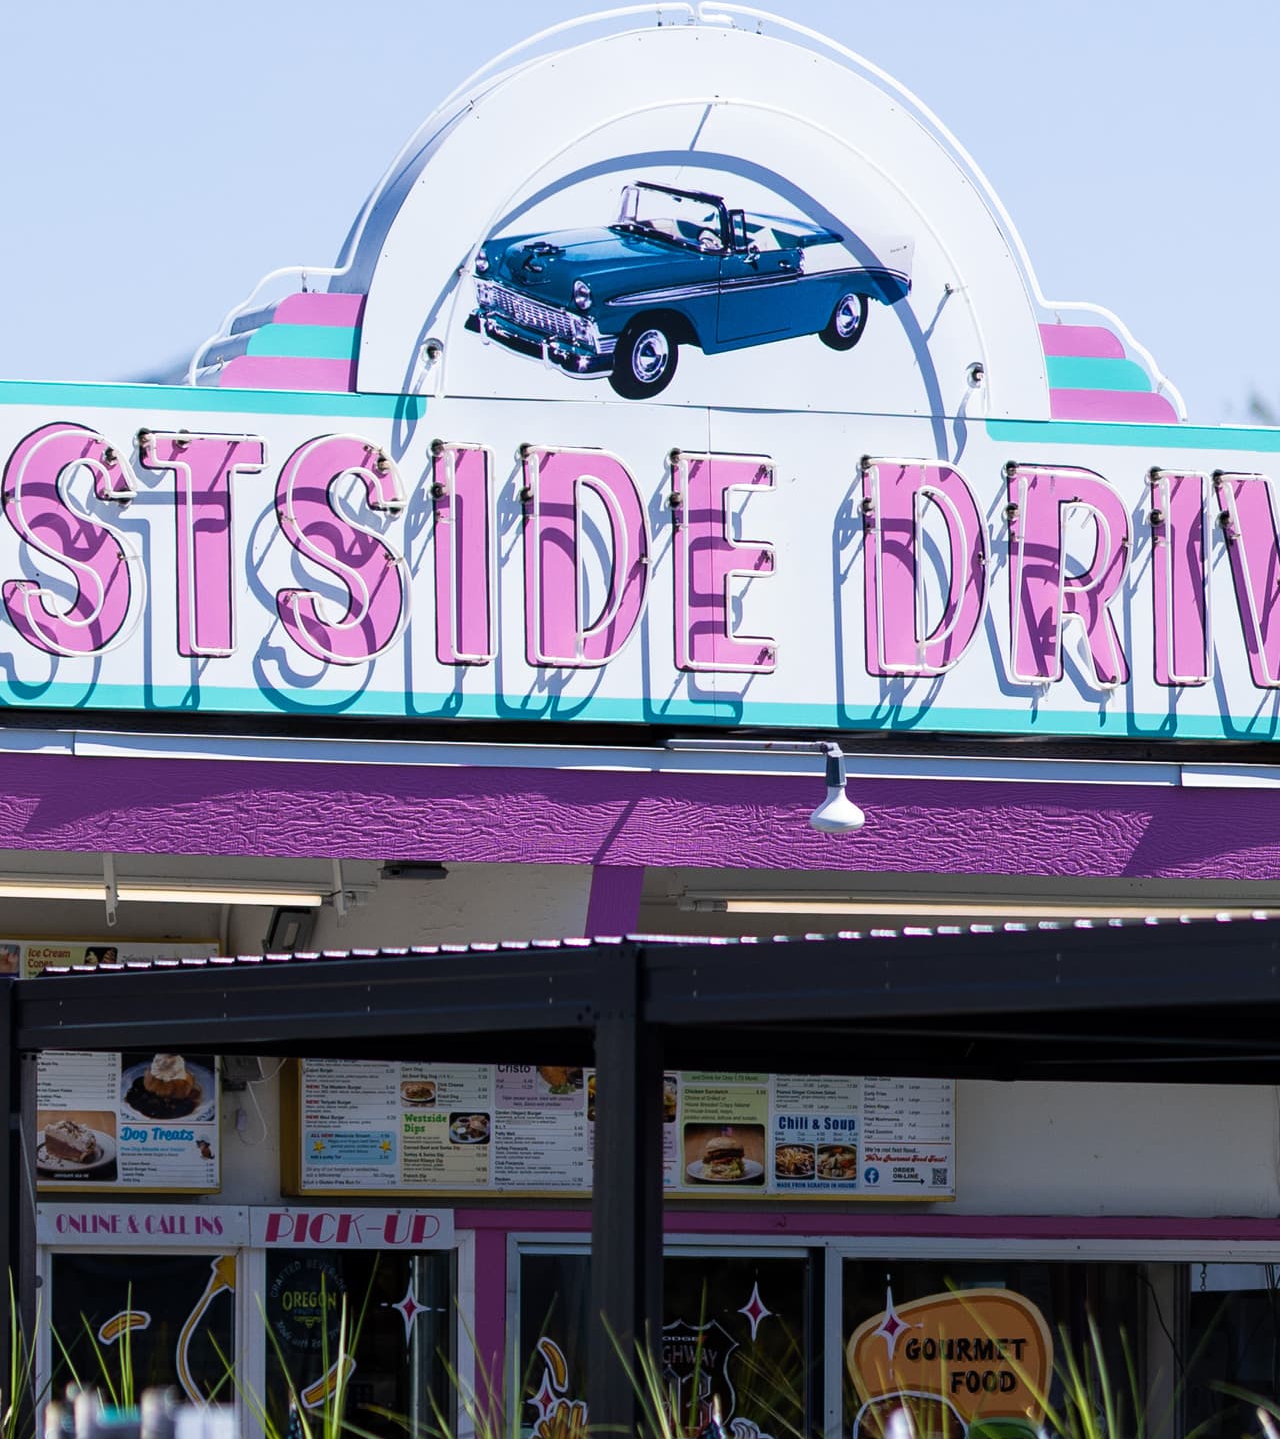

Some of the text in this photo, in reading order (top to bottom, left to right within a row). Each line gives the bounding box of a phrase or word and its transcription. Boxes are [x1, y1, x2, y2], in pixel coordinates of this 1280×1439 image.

[497, 1064, 531, 1074] Cristo
[404, 1113, 447, 1123] Westside
[778, 1116, 856, 1131] Chili & Soup
[120, 1126, 194, 1143] Dog Treats
[404, 1123, 426, 1135] Dips
[56, 1213, 223, 1235] ONLINE & CALL INS
[265, 1212, 441, 1244] PICK-UP
[663, 1345, 719, 1369] GHWAY
[905, 1337, 1027, 1364] GOURMET
[950, 1370, 1018, 1394] FOOD
